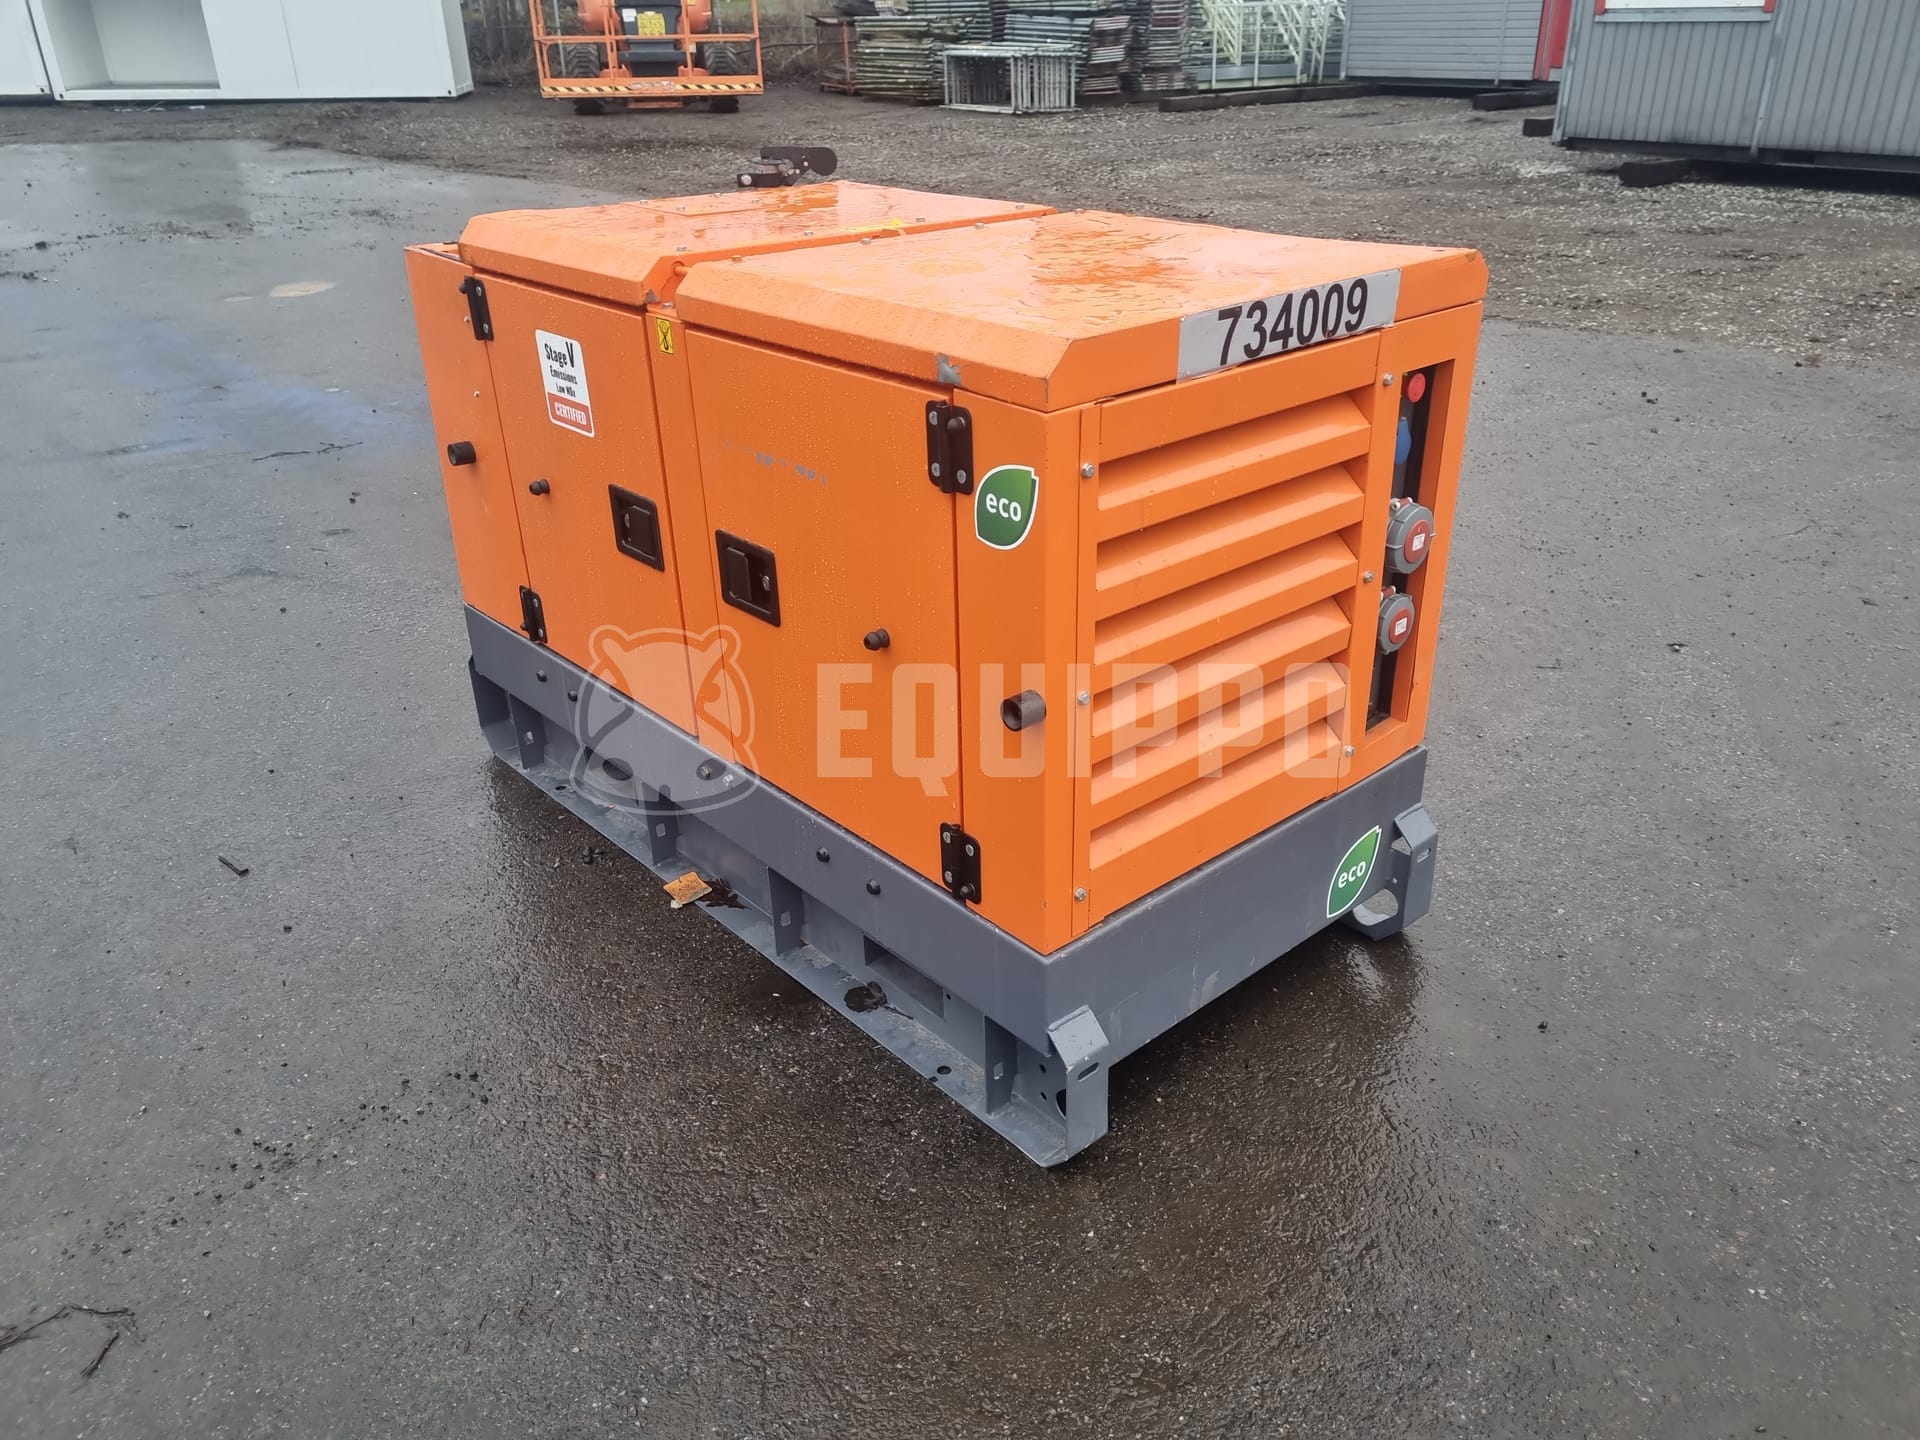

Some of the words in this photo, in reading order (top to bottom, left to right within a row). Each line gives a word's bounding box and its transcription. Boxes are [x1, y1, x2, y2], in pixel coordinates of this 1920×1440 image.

[1217, 277, 1369, 367] 734009
[544, 343, 567, 367] Stage
[565, 341, 574, 368] V
[550, 365, 577, 384] Emissions
[555, 402, 586, 425] CERTIFIED
[985, 493, 1022, 522] eco
[1337, 860, 1367, 889] eco
